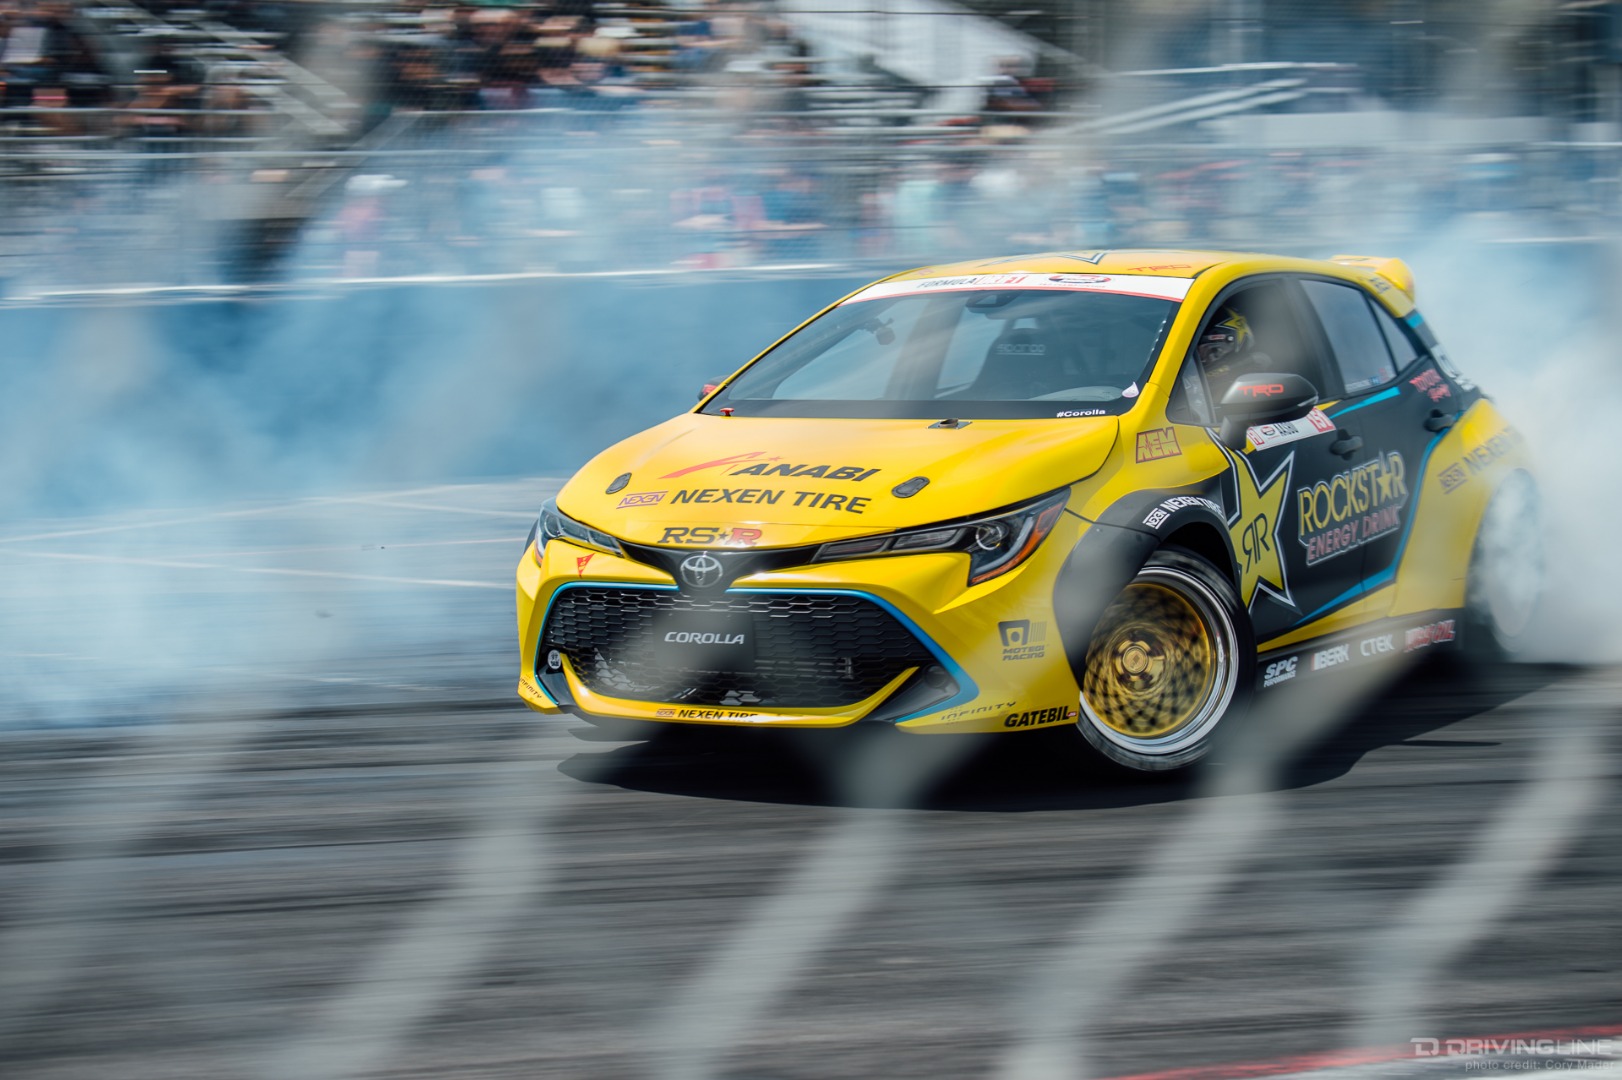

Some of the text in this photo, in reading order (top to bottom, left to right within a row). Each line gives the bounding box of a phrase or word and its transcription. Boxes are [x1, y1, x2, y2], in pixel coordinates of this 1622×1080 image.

[1237, 383, 1284, 397] TRD
[1056, 408, 1106, 418] #Corolla
[1136, 426, 1182, 464] AEM
[671, 488, 784, 505] NEXEN
[792, 491, 872, 514] TIRE
[1160, 496, 1204, 512] NEXEN
[1308, 504, 1399, 560] ENERGY DRINK
[664, 631, 745, 645] COROLLA
[1003, 645, 1045, 654] MOTEGI
[1003, 651, 1045, 660] RACING
[1264, 656, 1298, 680] SPC
[1316, 643, 1350, 669] BERK
[1360, 634, 1395, 657] CTEK
[677, 709, 724, 719] NEXEN
[1004, 705, 1070, 728] GATEBIL
